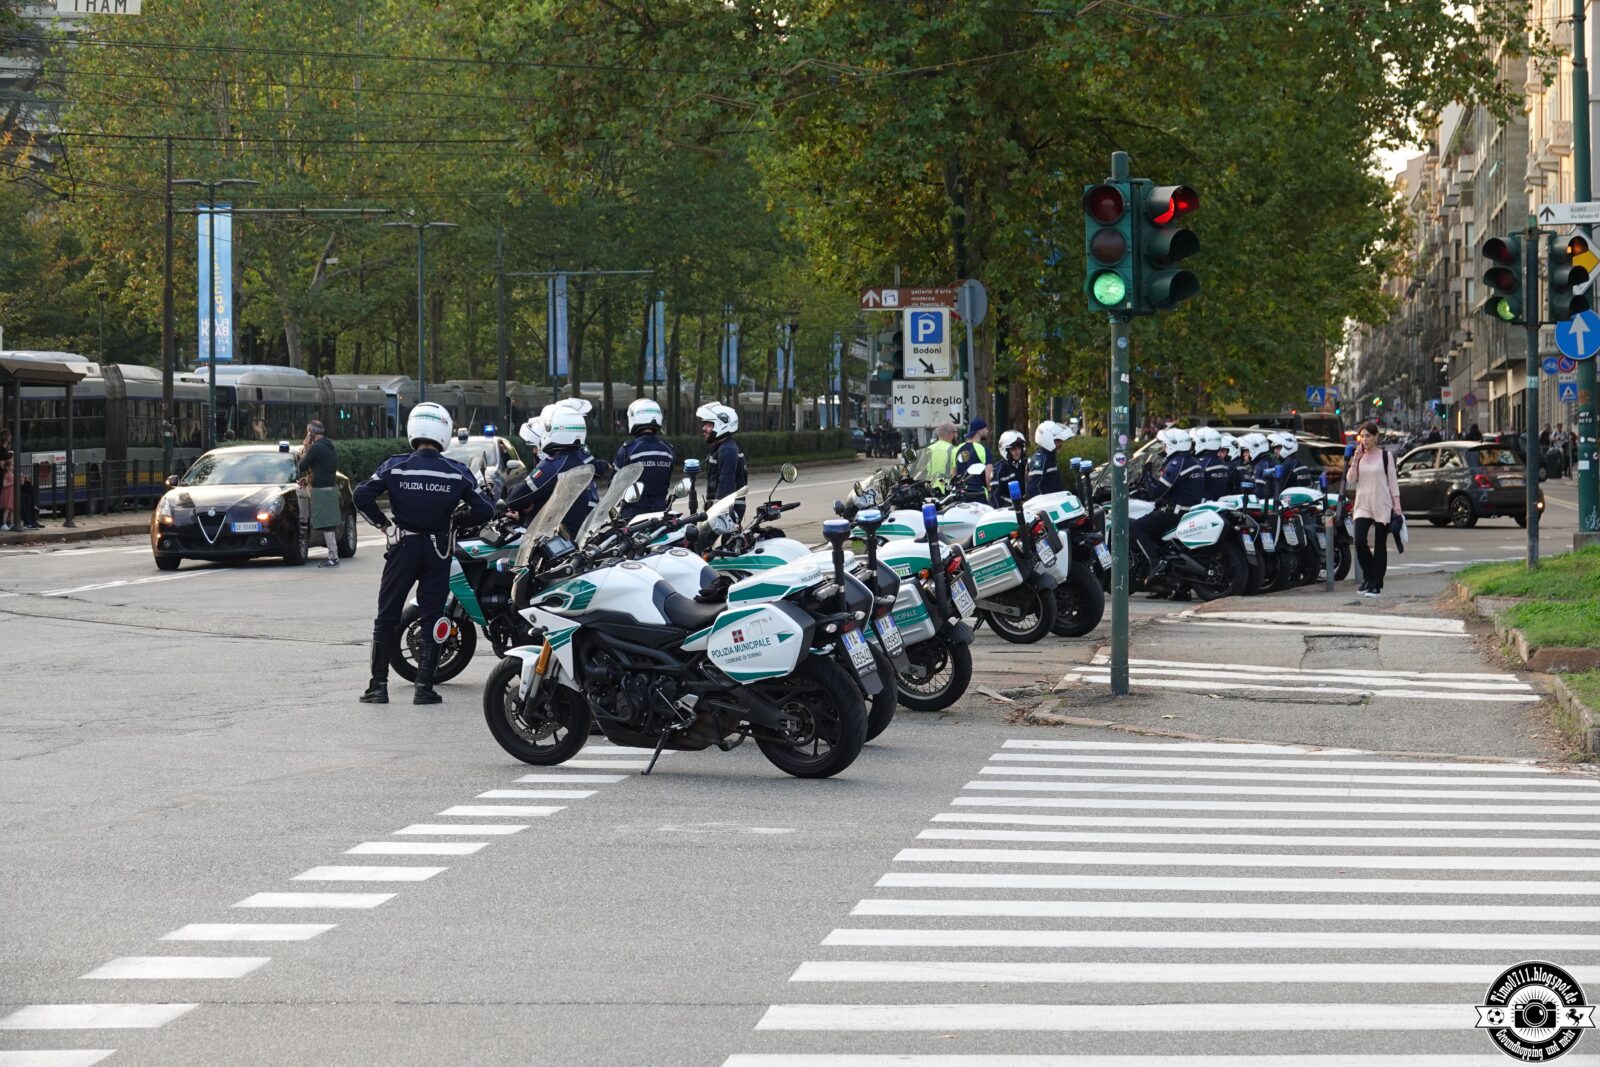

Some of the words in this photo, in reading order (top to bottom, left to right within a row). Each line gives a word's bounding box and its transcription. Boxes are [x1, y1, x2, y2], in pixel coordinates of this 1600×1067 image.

[918, 319, 936, 342] P
[894, 396, 905, 405] M.
[912, 395, 963, 407] D'Azeglio
[399, 481, 423, 490] POLIZIA
[425, 483, 451, 493] LOCALE
[711, 645, 735, 658] POLIZIA
[734, 637, 771, 653] MUNICIPALE
